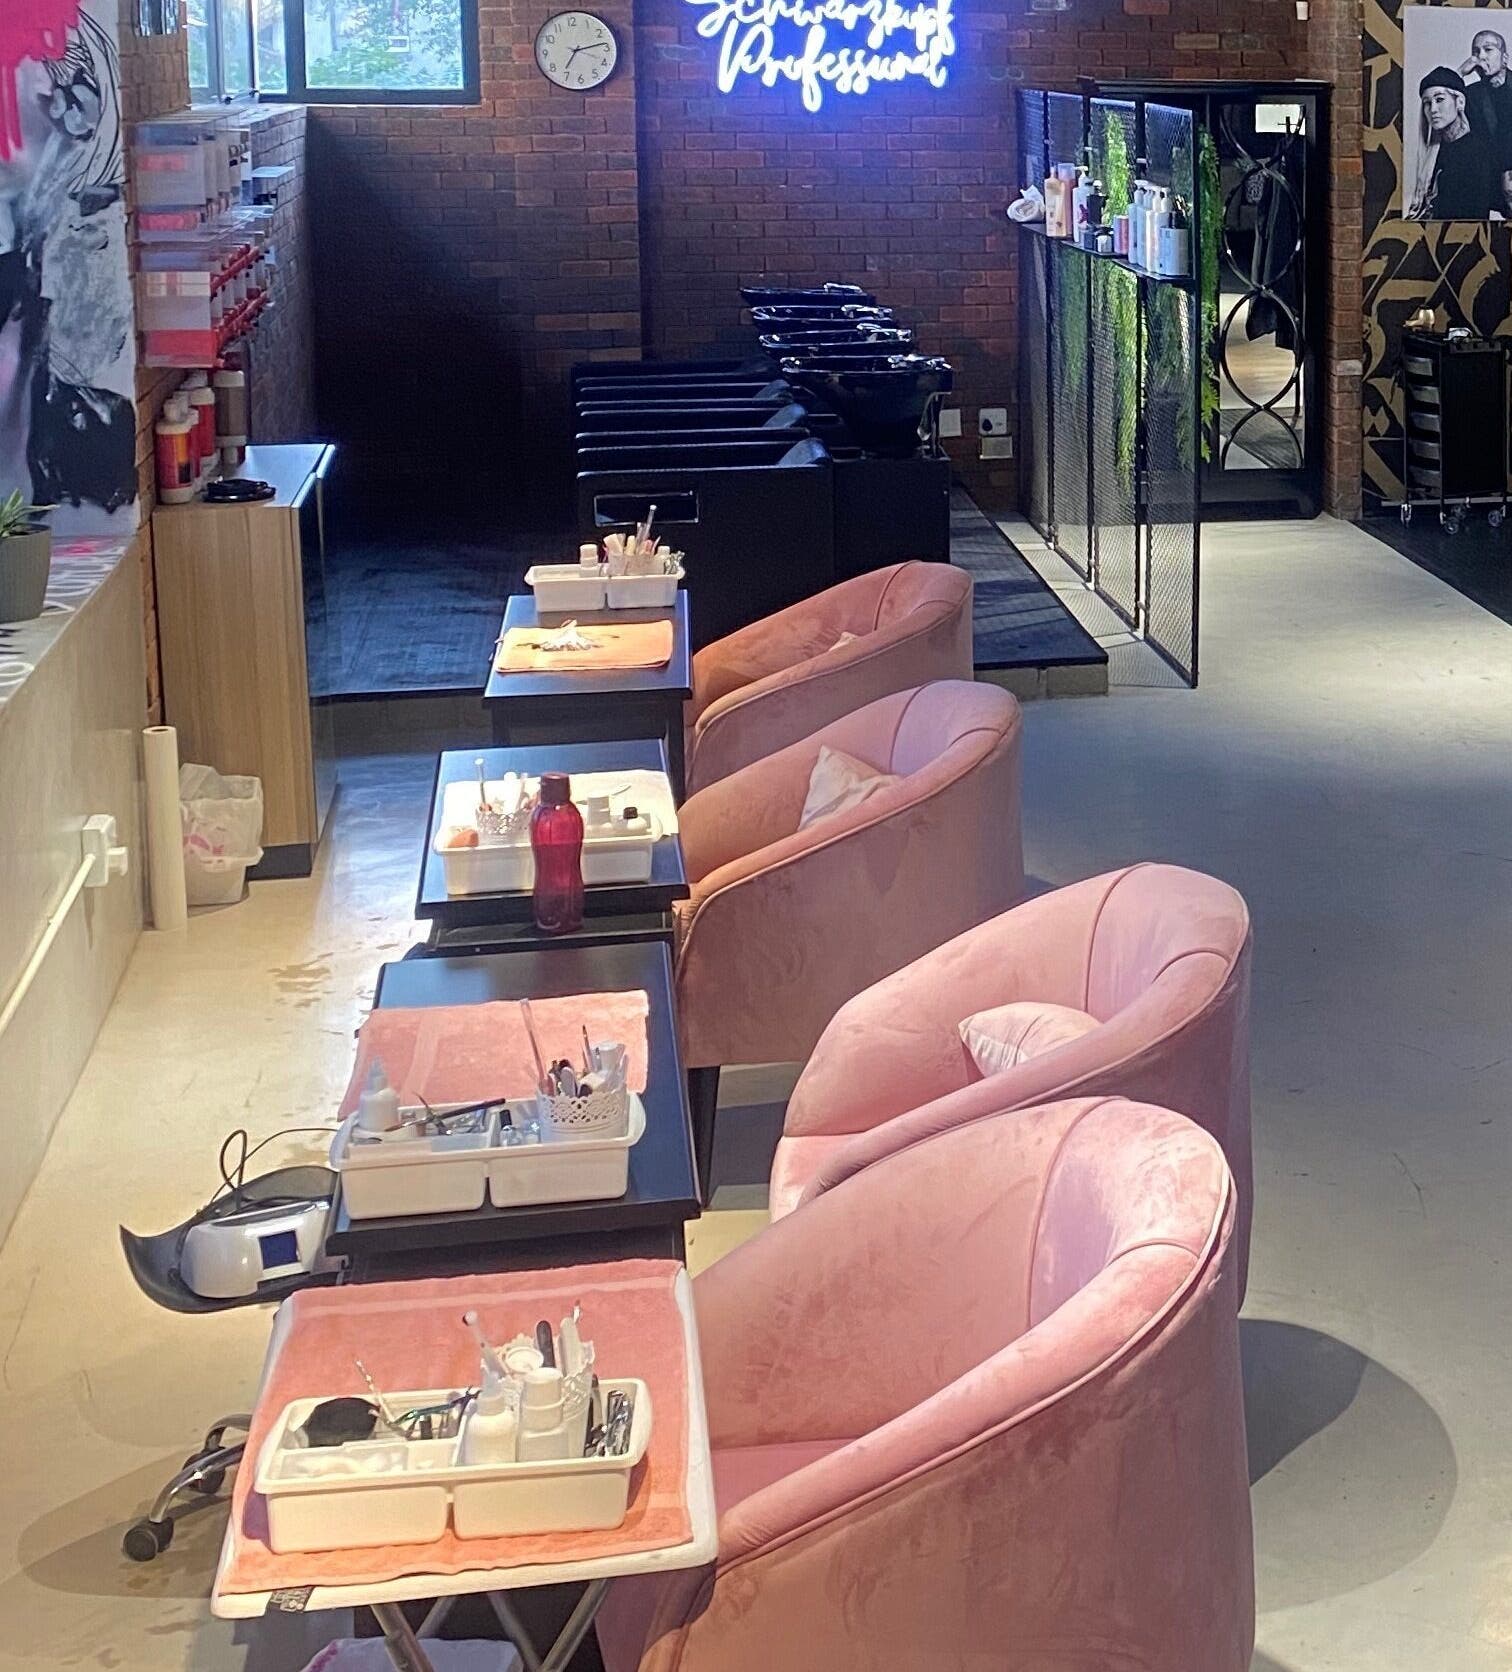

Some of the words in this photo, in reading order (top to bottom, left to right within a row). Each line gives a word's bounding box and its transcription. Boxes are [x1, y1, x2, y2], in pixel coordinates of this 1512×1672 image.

[567, 17, 577, 27] 12
[585, 19, 590, 29] 1
[554, 23, 562, 33] 11
[595, 28, 603, 39] 2
[545, 35, 555, 44] 10
[603, 43, 611, 52] 3
[542, 49, 549, 59] 9
[601, 58, 608, 66] 4
[716, 18, 948, 113] Professional
[549, 63, 557, 72] 8
[563, 71, 570, 81] 7
[577, 74, 585, 84] 6
[592, 69, 599, 79] 5
